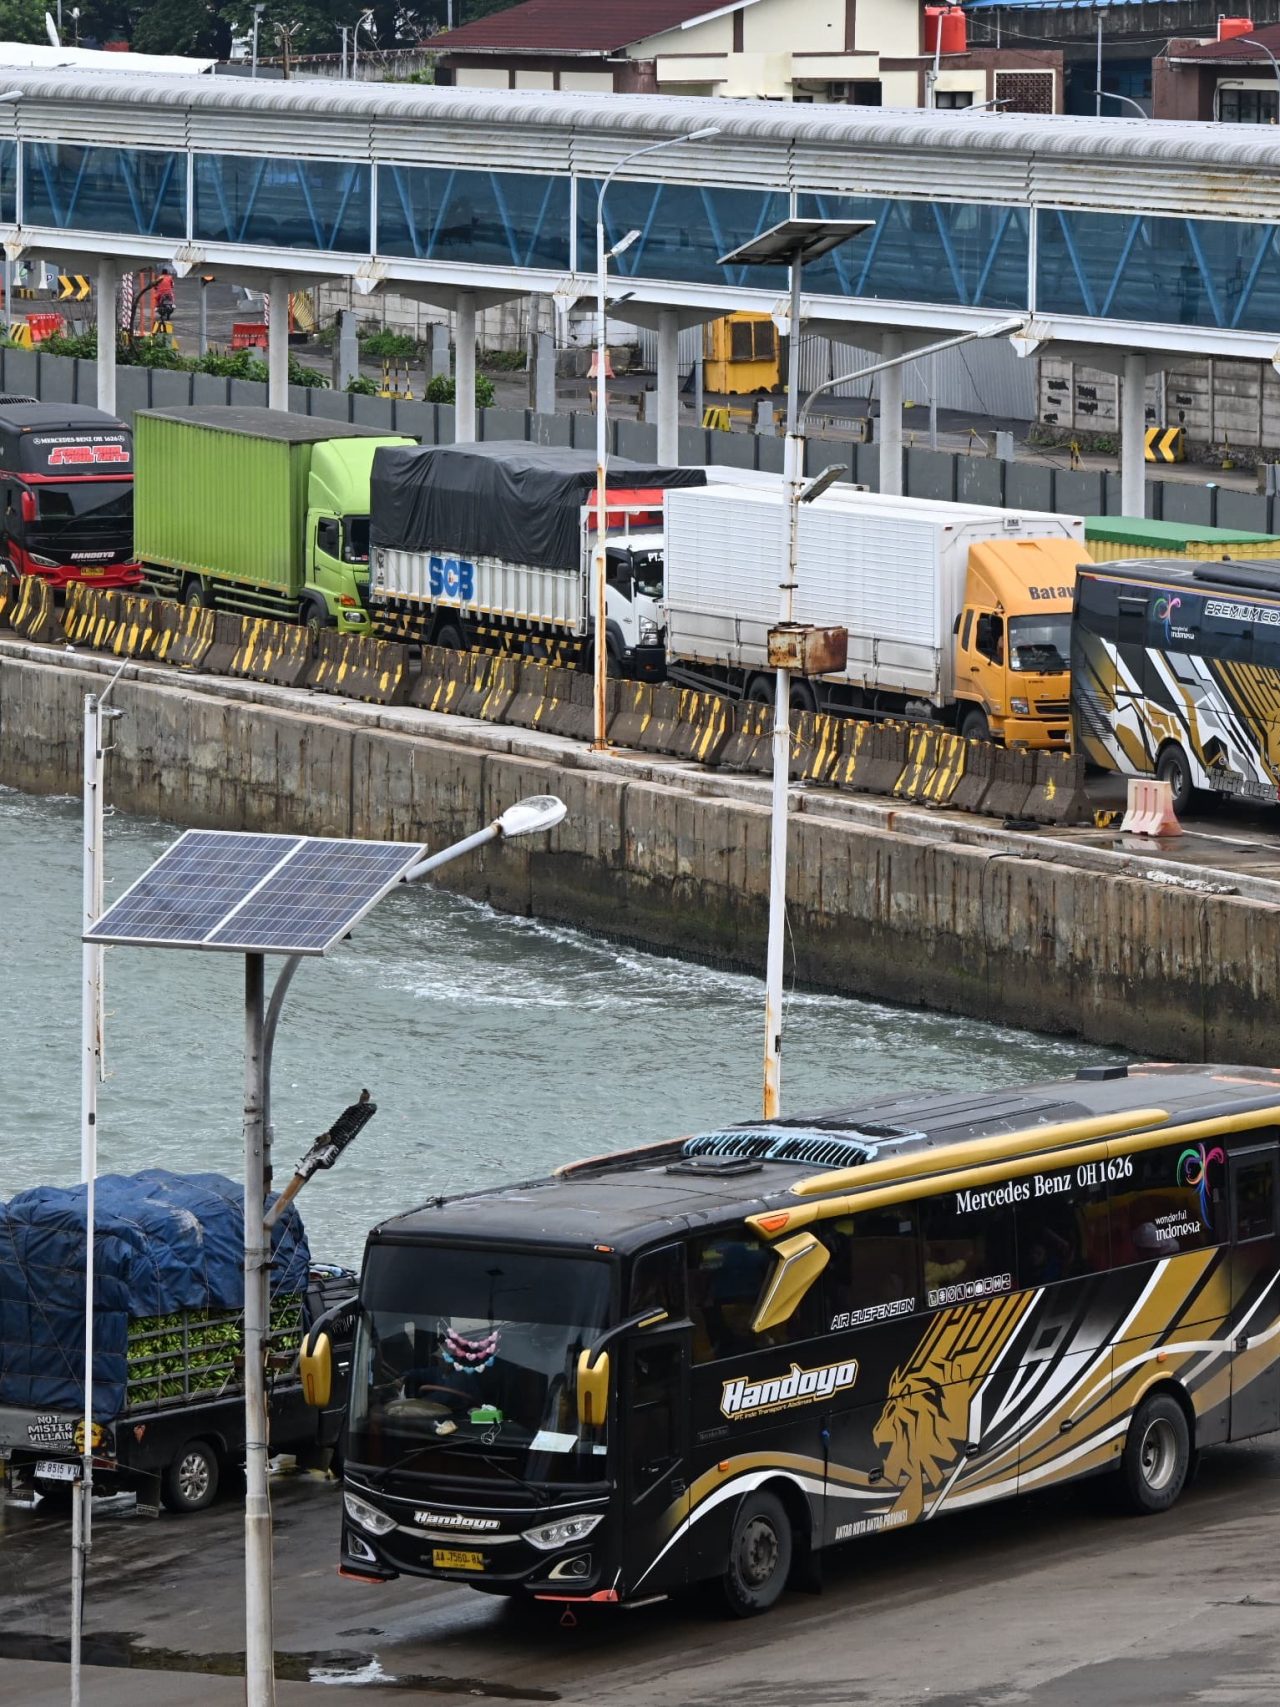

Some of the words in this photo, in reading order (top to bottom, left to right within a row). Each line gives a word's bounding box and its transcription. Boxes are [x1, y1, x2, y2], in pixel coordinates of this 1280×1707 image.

[70, 551, 115, 559] HANDOYO
[429, 555, 474, 600] SCB
[1205, 600, 1260, 622] PREMIUM
[956, 1179, 1030, 1214] Mercedes
[1034, 1174, 1072, 1197] Benz
[1076, 1164, 1097, 1187] OH
[1099, 1155, 1133, 1182] 1626
[1155, 1209, 1187, 1225] wonderful
[1155, 1219, 1200, 1242] indonesia
[830, 1312, 850, 1330] AIR
[851, 1297, 915, 1325] SUSPENSION
[721, 1361, 857, 1416] Handoyo
[28, 1423, 73, 1433] MISTER
[36, 1415, 60, 1424] NOT
[29, 1431, 73, 1441] VILLAIN
[36, 1462, 46, 1472] BE
[47, 1463, 64, 1474] 8515
[414, 1511, 500, 1529] Handoyo
[835, 1525, 853, 1540] ANTAR
[866, 1515, 883, 1532] ANTAR
